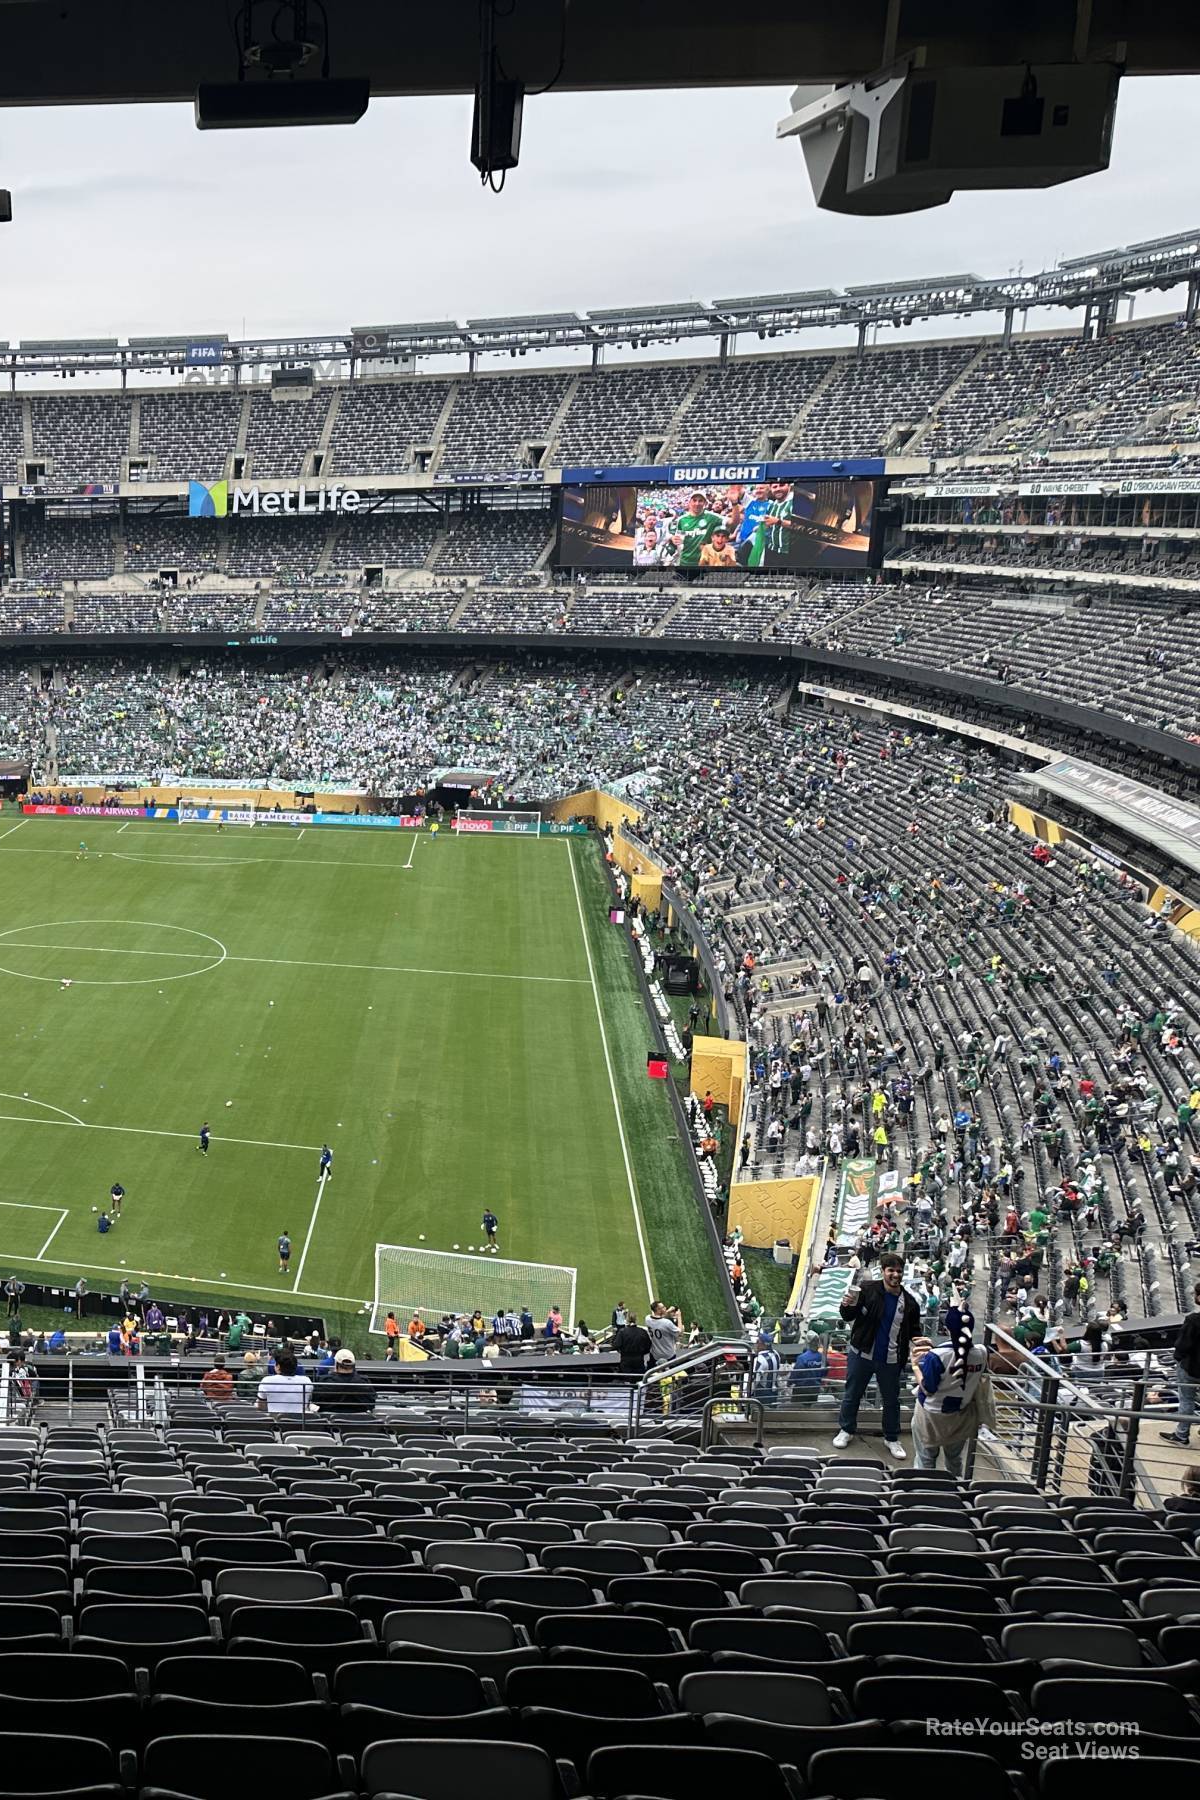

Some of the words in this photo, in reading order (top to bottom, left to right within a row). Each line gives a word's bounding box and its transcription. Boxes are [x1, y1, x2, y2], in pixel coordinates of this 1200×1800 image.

[191, 347, 216, 358] FIFA
[674, 467, 708, 481] BUD
[710, 466, 759, 480] LIGHT
[934, 487, 943, 495] 32
[1030, 484, 1041, 494] 80
[1042, 484, 1062, 493] WAYNE
[1121, 481, 1133, 493] 60
[232, 482, 361, 514] MetLife
[74, 806, 101, 815] QATAR
[104, 807, 139, 816] AIRWAYS
[177, 809, 199, 818] VISA
[229, 812, 250, 820] BANK
[514, 823, 528, 831] PIF
